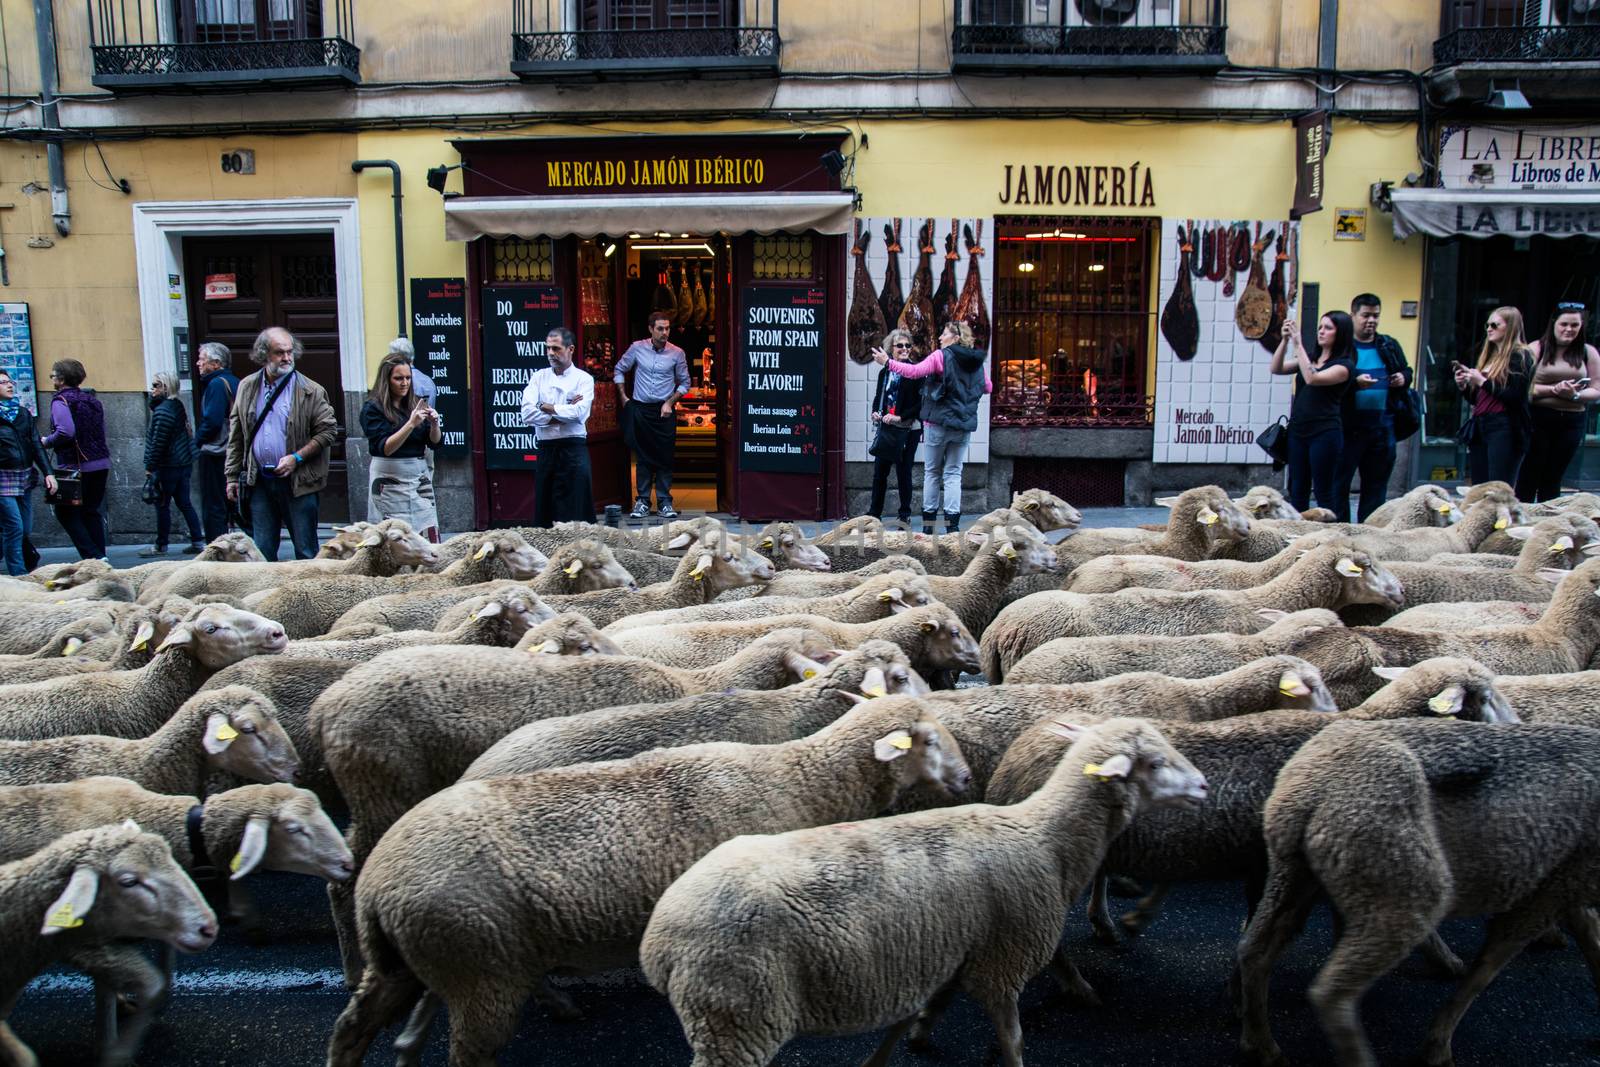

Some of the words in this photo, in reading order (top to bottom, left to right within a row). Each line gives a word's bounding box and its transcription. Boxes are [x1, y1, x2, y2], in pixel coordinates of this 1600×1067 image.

[1460, 129, 1501, 161] LA
[221, 153, 242, 173] 80
[547, 161, 626, 187] MERCADO
[631, 155, 689, 186] JAMÓN
[695, 155, 764, 185] IBÉRICO
[1511, 161, 1561, 183] Libros
[1565, 161, 1585, 183] de
[998, 161, 1156, 207] JAMONERÍA
[1456, 205, 1499, 232] LA
[497, 300, 513, 316] DO
[749, 307, 815, 325] SOUVENIRS
[415, 313, 462, 326] Sandwiches
[506, 321, 528, 336] YOU
[432, 334, 446, 343] are
[748, 329, 782, 346] FROM
[784, 330, 819, 347] SPAIN
[428, 347, 451, 360] made
[515, 341, 547, 356] WANT
[748, 351, 780, 368] WITH
[432, 365, 448, 379] just
[747, 373, 804, 391] FLAVOR!!!
[493, 390, 524, 406] ACOR
[748, 404, 771, 415] Iberian
[771, 407, 798, 418] sausage
[1175, 408, 1214, 424] Mercado
[493, 411, 529, 428] CURE
[753, 423, 776, 434] Iberian
[777, 424, 792, 435] Loin
[1174, 425, 1211, 444] Jamón
[1214, 425, 1254, 444] Ibérico
[744, 442, 767, 453] Iberian
[768, 443, 786, 453] cured
[787, 443, 802, 454] ham
